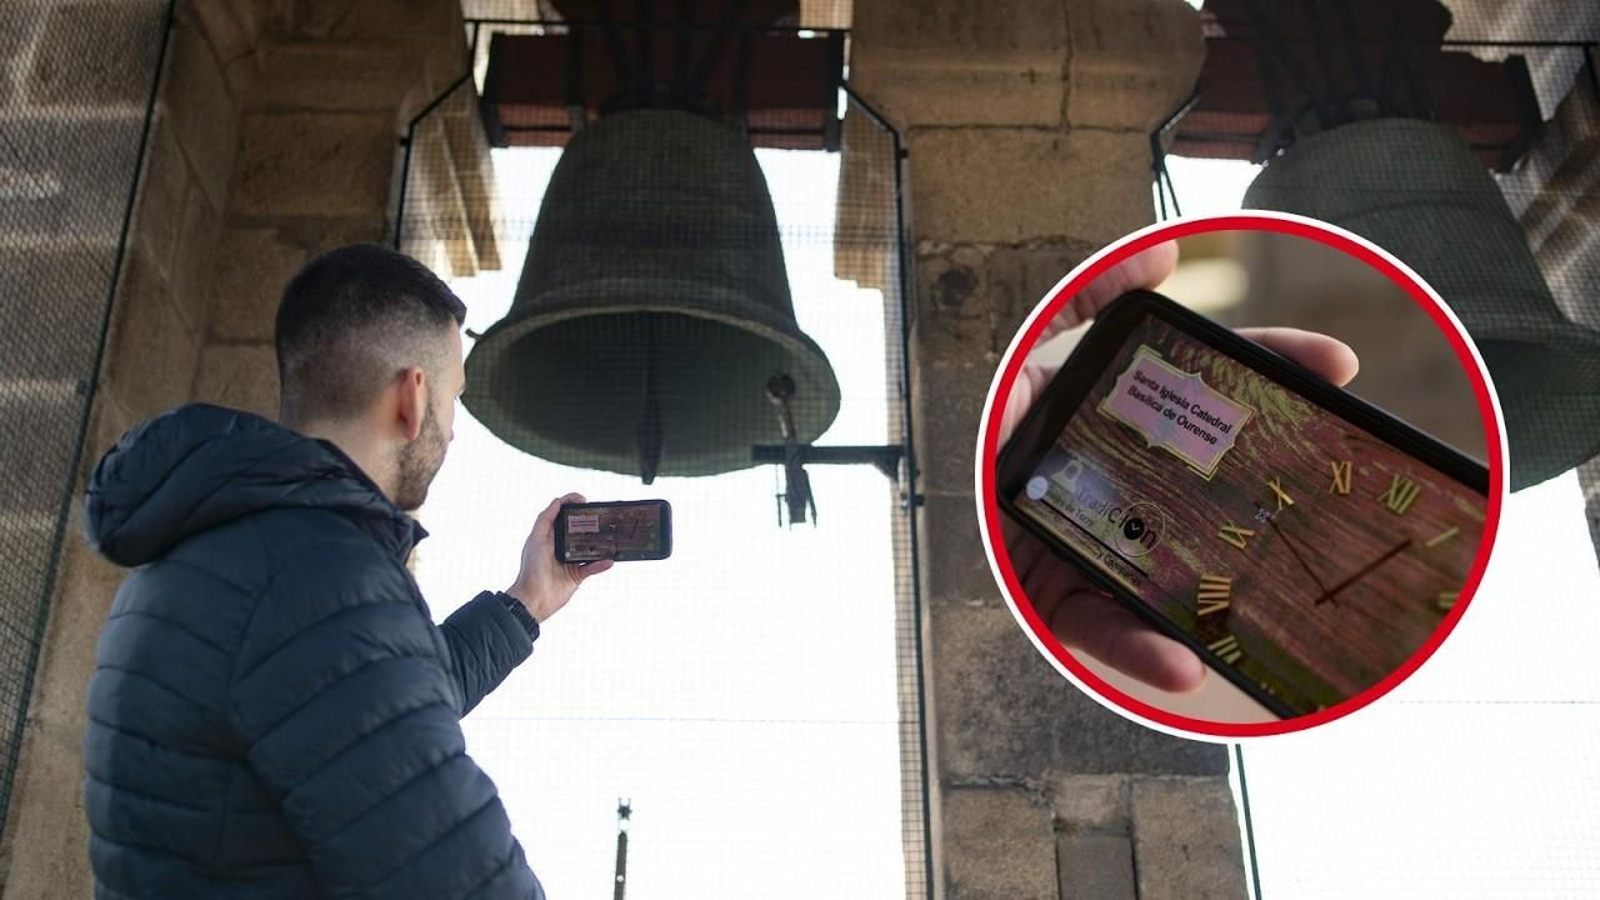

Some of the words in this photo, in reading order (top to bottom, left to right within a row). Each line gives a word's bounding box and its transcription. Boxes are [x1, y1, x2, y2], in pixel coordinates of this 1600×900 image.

[1133, 370, 1160, 393] Santa
[1159, 384, 1190, 411] Iglesia
[1190, 404, 1232, 434] Catedral
[1163, 406, 1176, 421] de
[1176, 414, 1218, 446] Ourense
[1330, 460, 1353, 495] XI
[1378, 474, 1420, 515] XII
